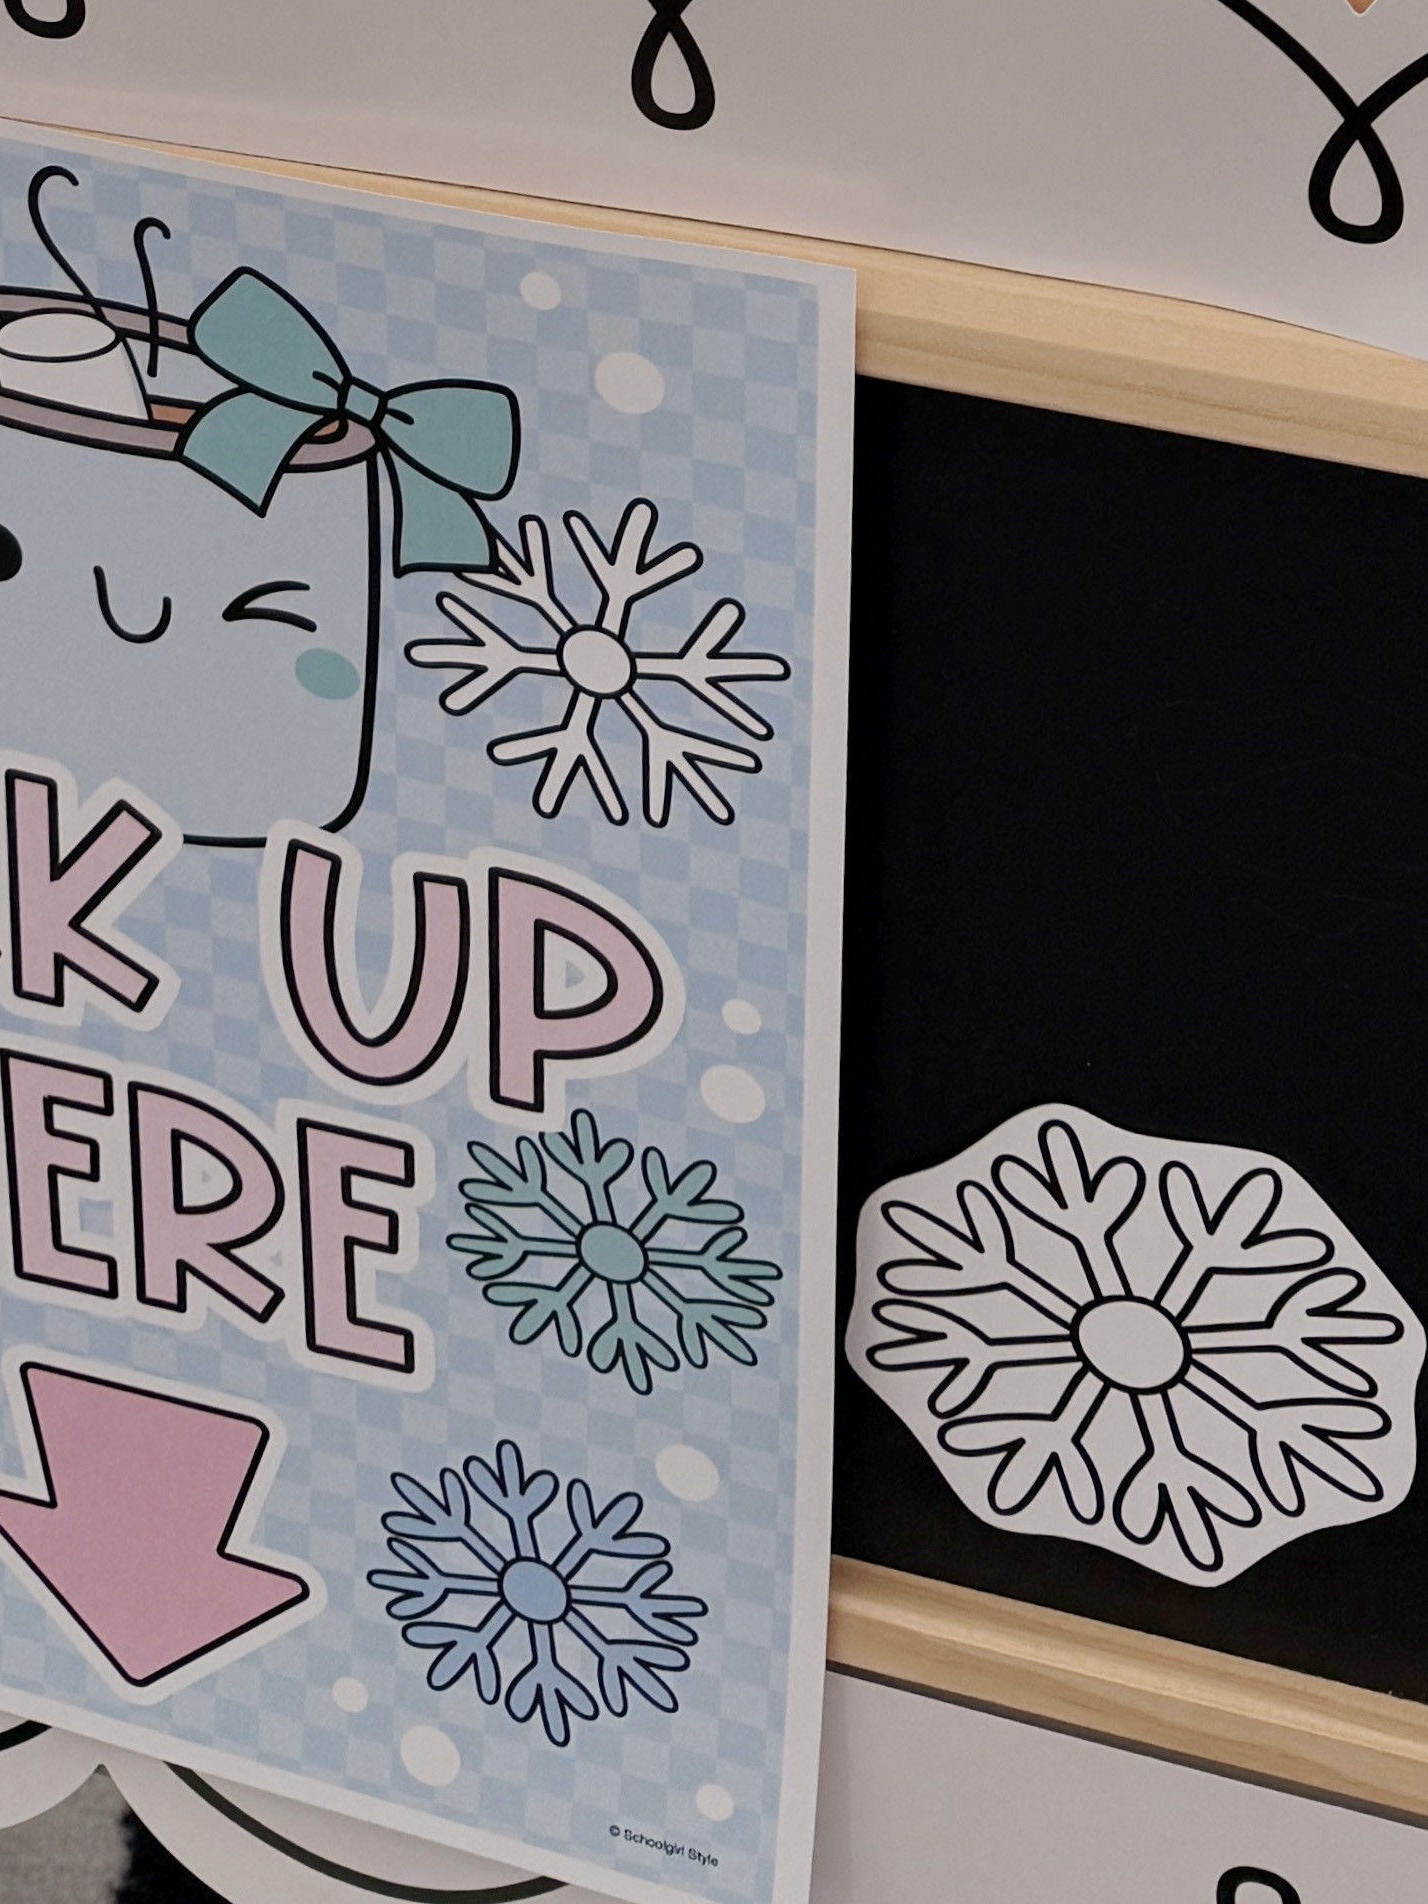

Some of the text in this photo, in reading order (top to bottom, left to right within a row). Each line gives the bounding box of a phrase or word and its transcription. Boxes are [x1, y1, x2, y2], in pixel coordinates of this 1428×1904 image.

[279, 837, 666, 1112] UP
[623, 1829, 684, 1856] Schoolgirl
[688, 1848, 719, 1867] Style
